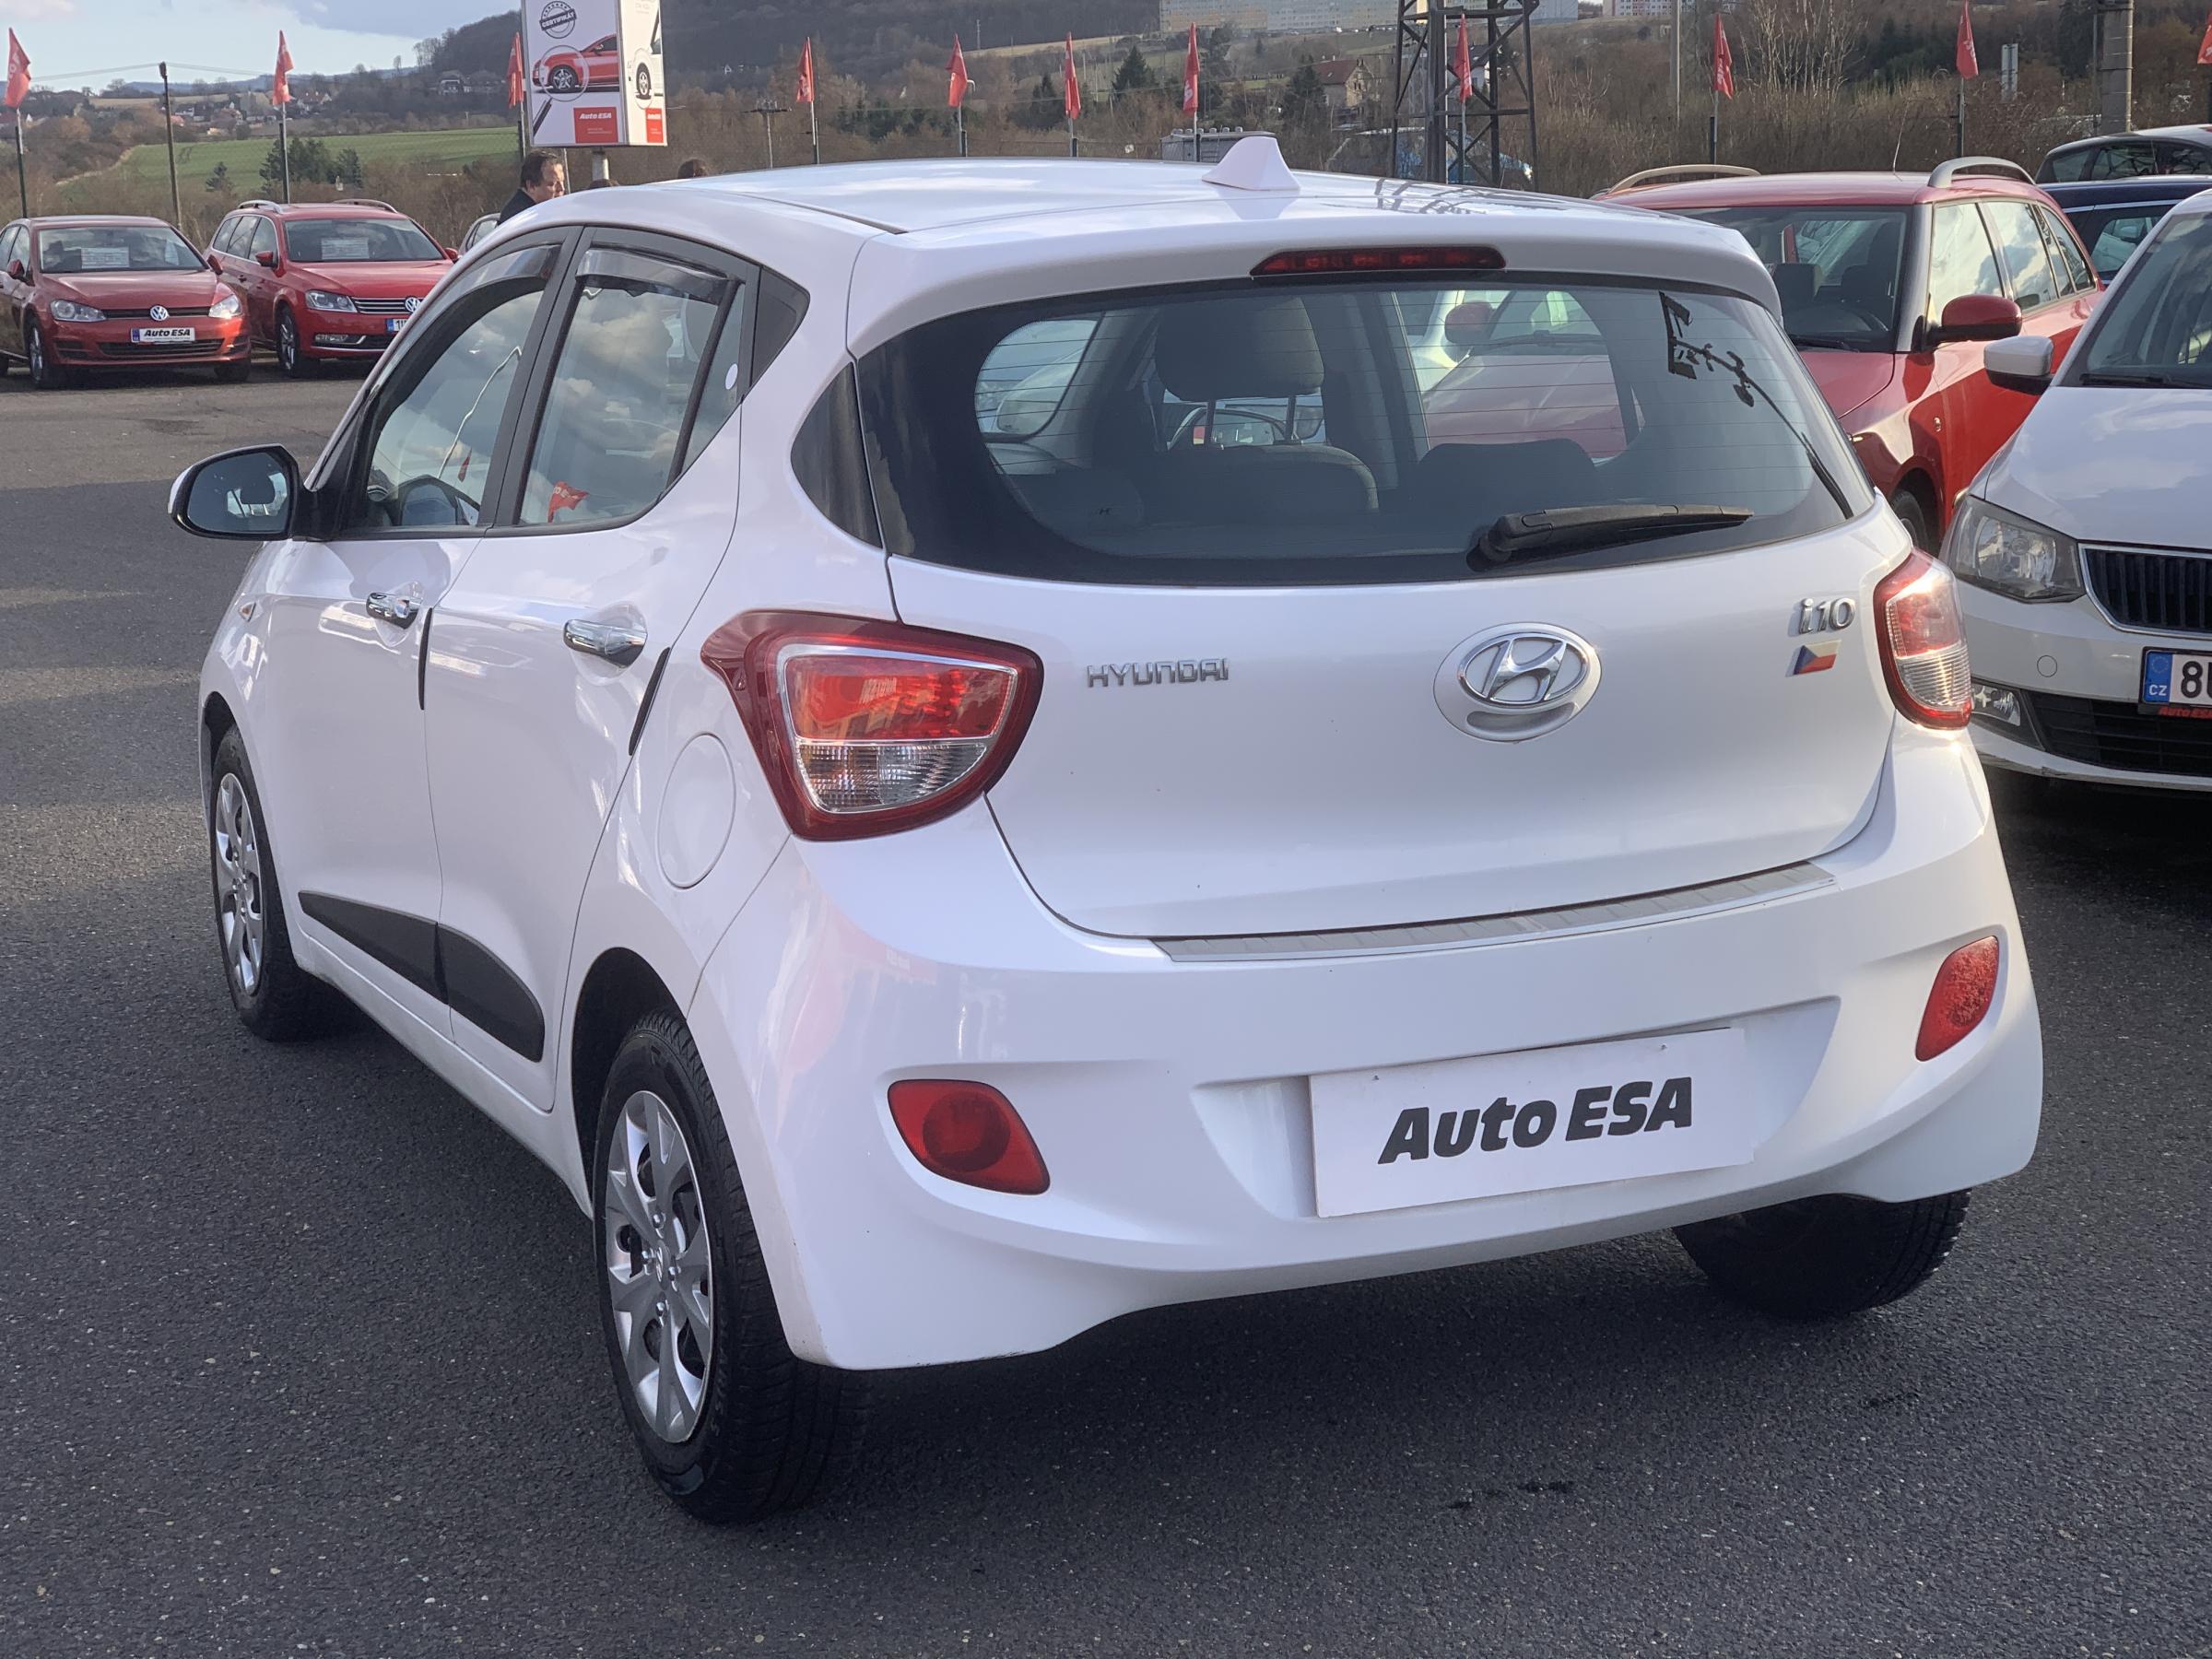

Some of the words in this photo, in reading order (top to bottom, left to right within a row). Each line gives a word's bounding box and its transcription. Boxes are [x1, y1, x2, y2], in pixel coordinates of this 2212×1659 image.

[144, 329, 170, 337] Auto
[1799, 597, 1855, 635] i10
[1087, 658, 1229, 688] HYUNDAI
[2148, 684, 2168, 696] CZ
[2181, 661, 2212, 699] 8
[1378, 1097, 1558, 1165] Auto
[1565, 1077, 1692, 1141] ESA
